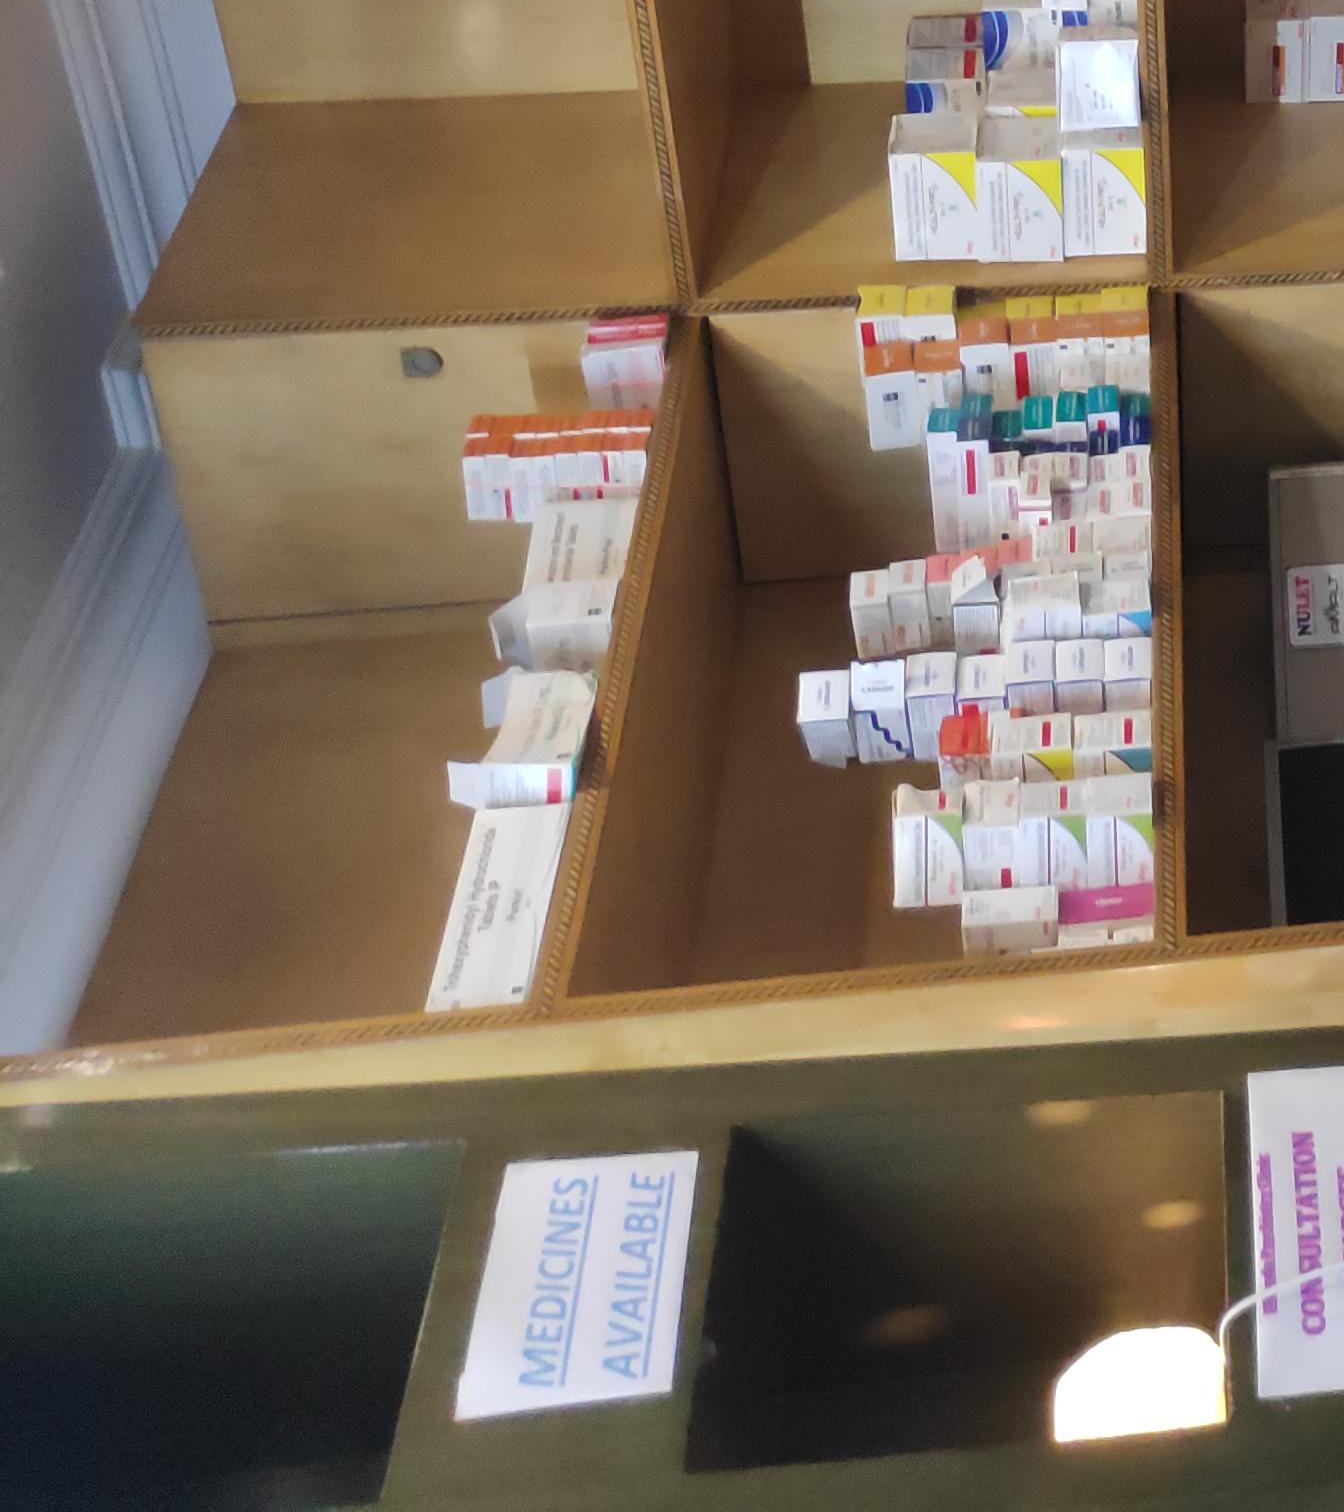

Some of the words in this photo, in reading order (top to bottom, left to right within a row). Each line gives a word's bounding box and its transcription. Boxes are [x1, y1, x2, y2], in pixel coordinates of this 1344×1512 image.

[1295, 574, 1312, 635] NULET
[518, 1175, 590, 1386] MEDICINES
[601, 1170, 667, 1378] AVAILABLE
[1291, 1129, 1327, 1334] CONSULTATION
